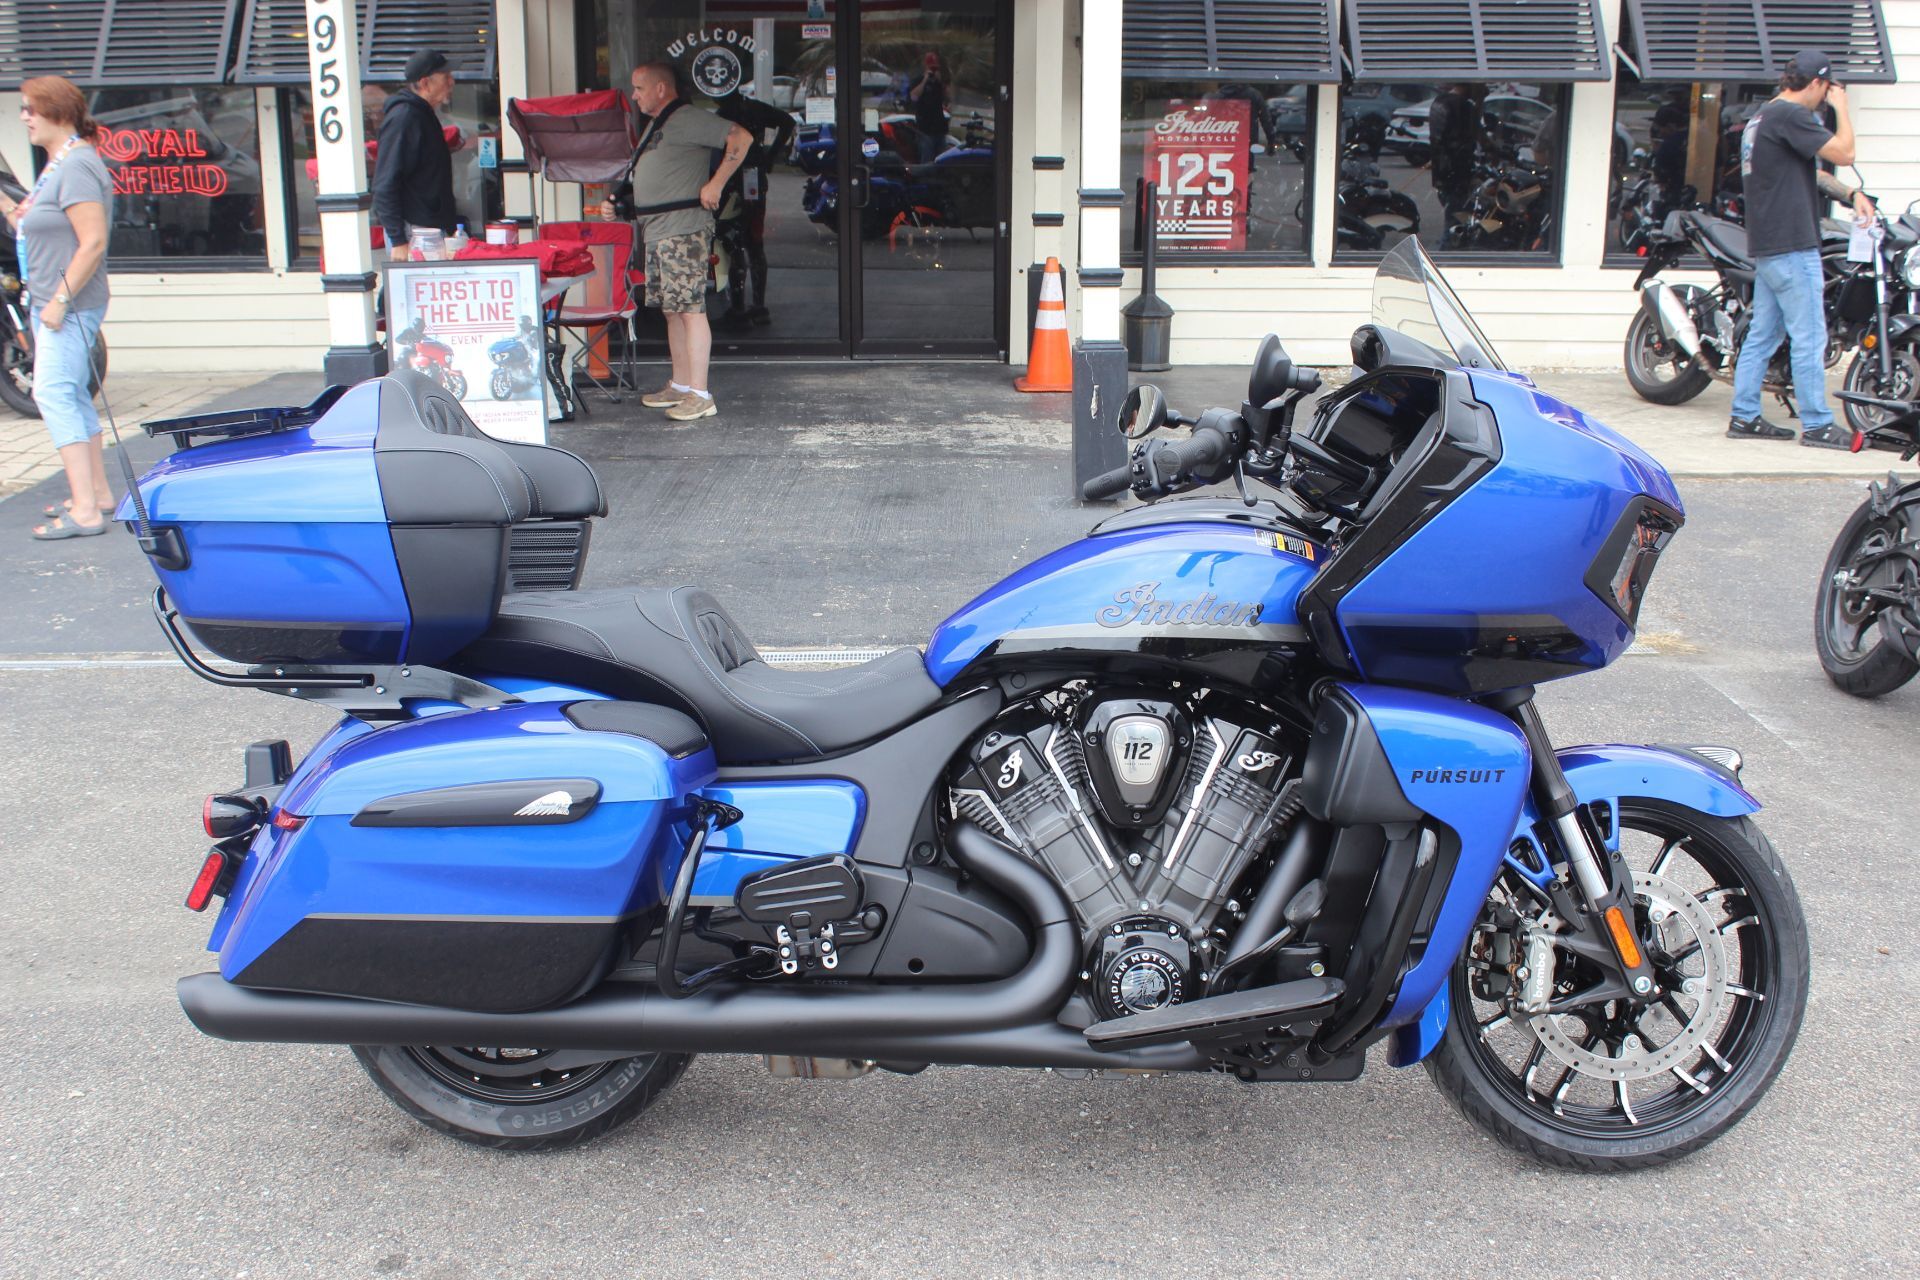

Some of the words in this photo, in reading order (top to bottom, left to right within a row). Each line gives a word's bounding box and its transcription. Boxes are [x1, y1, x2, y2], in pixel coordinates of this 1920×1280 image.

[313, 0, 343, 143] 956
[1154, 110, 1239, 135] Indian
[96, 126, 207, 162] ROYAL
[107, 164, 227, 197] NFIELD
[1156, 153, 1235, 196] 125
[1156, 199, 1234, 217] YEARS
[486, 279, 514, 299] TO
[416, 303, 459, 324] THE
[465, 301, 516, 323] LINE
[451, 334, 485, 345] EVENT
[1094, 580, 1266, 629] Indian
[1123, 742, 1154, 760] 112
[1410, 769, 1506, 784] PURSUIT
[1111, 961, 1129, 1010] INDIAN
[1130, 952, 1182, 1005] MOTORCYCL
[1532, 952, 1547, 998] brembo
[531, 1057, 644, 1128] METZELER
